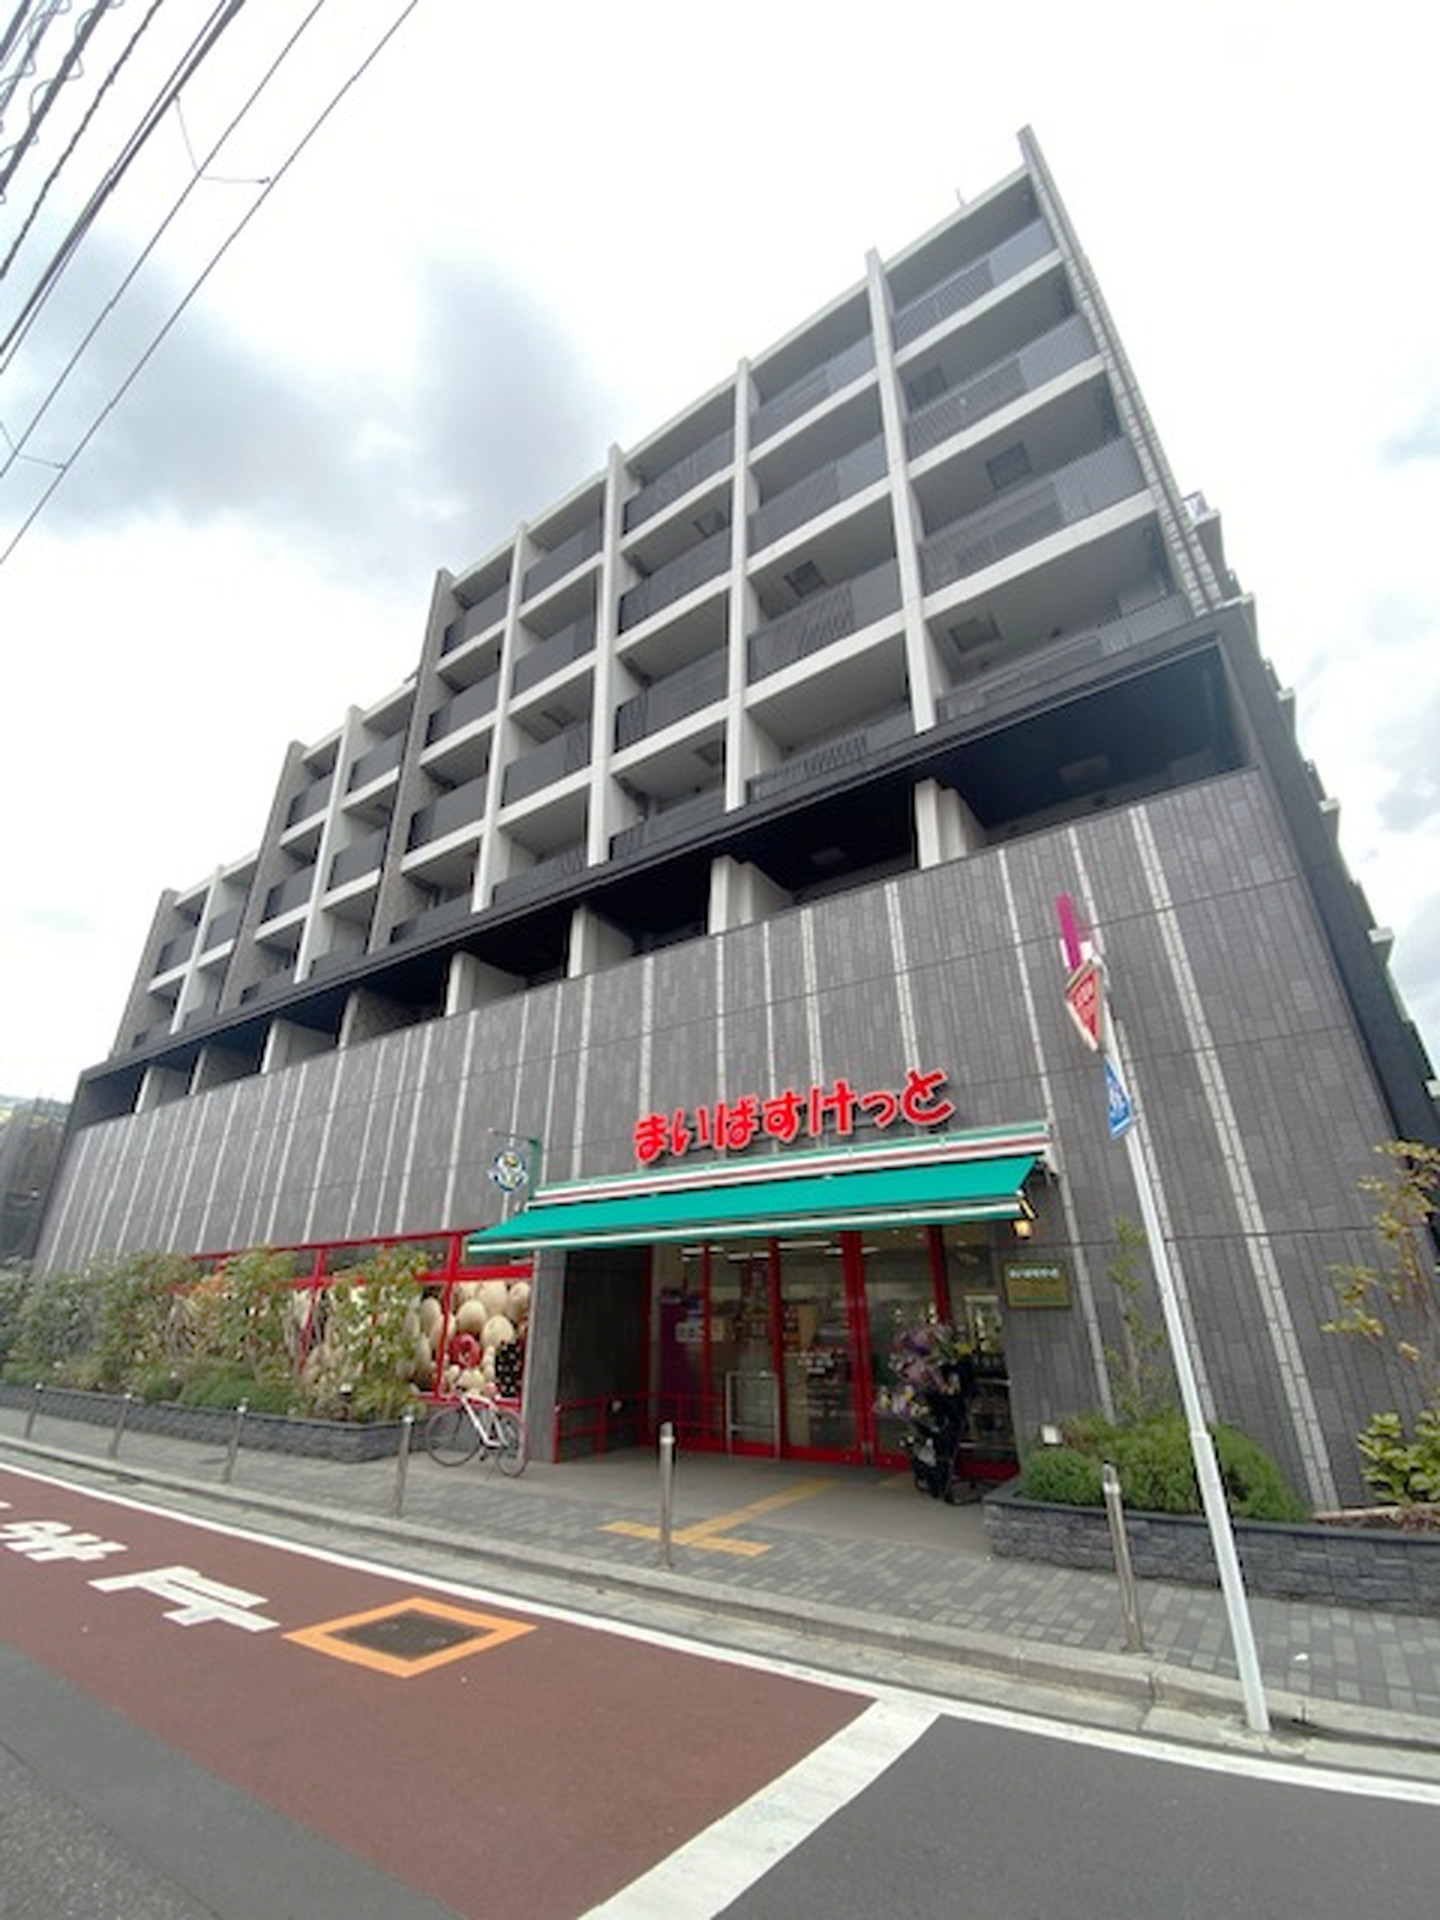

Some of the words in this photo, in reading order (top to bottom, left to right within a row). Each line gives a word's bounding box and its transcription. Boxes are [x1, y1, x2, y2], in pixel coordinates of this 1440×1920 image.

[634, 1068, 955, 1163] まいばすけっと
